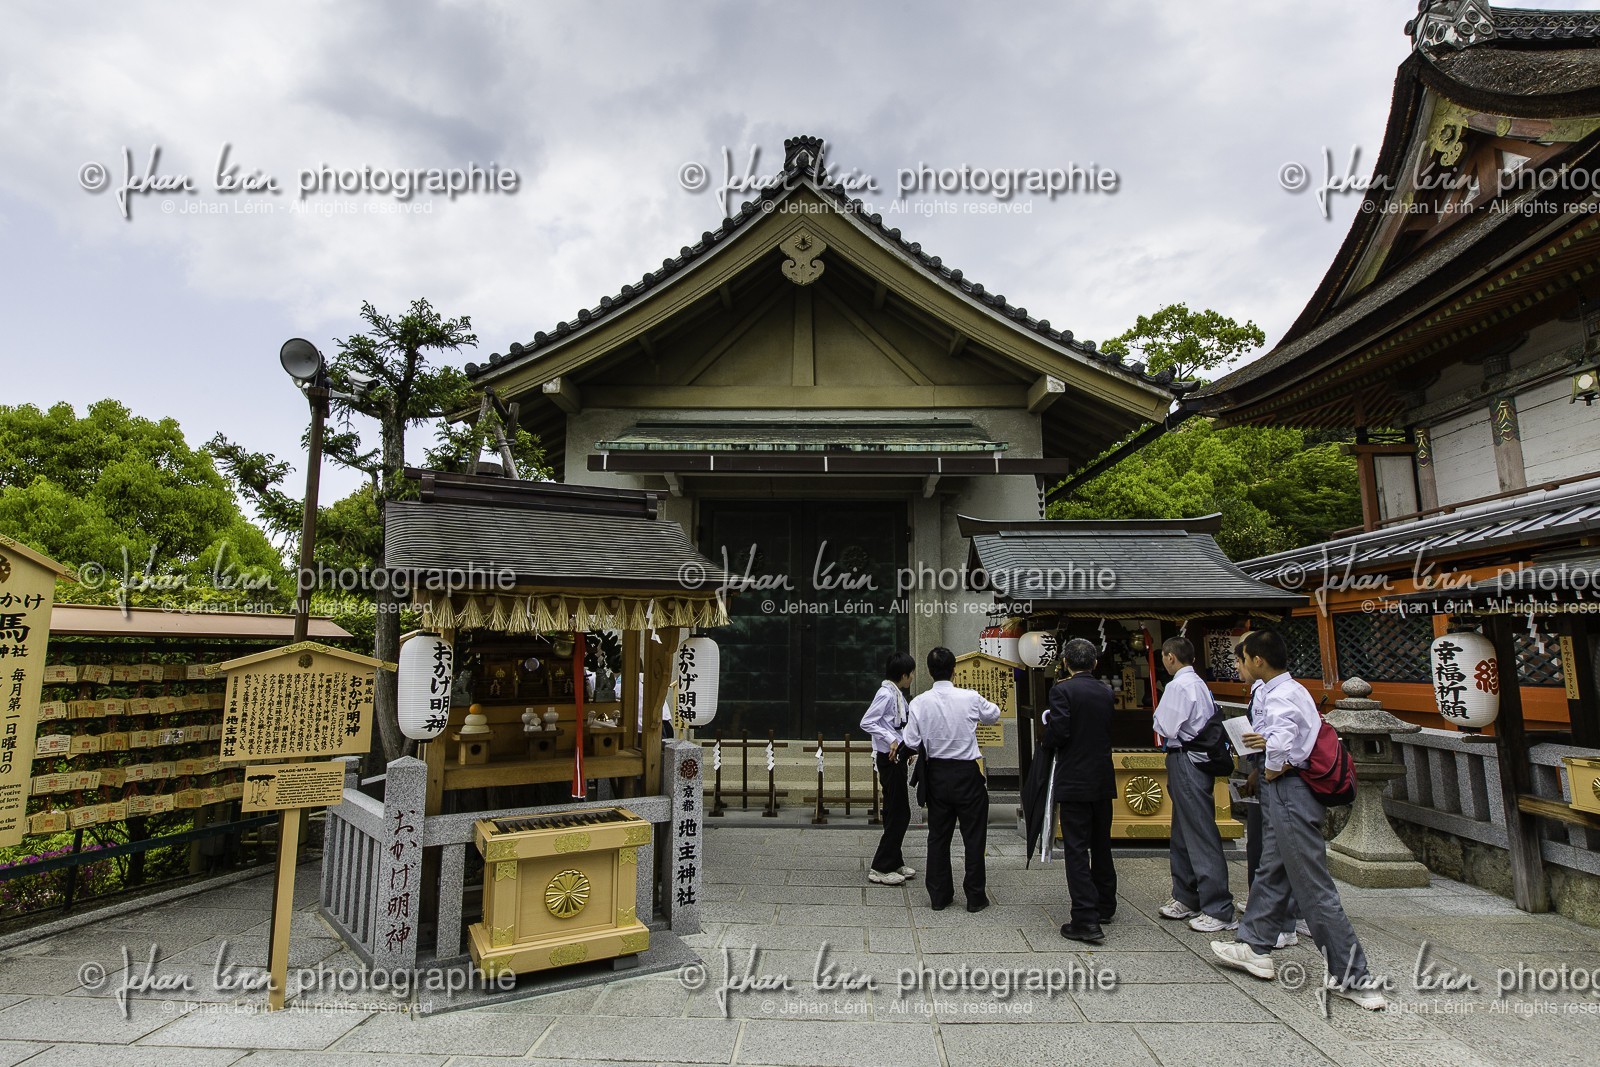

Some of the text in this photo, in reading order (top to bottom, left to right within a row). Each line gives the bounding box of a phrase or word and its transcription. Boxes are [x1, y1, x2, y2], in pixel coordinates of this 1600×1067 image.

[344, 674, 364, 737] おかげ明神
[363, 671, 375, 704] 一願成就
[421, 641, 453, 733] おかげ明神
[678, 644, 698, 722] おかげ明神
[1434, 641, 1470, 719] 幸福祈願
[0, 668, 26, 774] 毎月第一日曜日の
[222, 715, 239, 757] 地主神社
[385, 809, 418, 954] おかげ明神
[677, 785, 697, 907] 京都 地主神社
